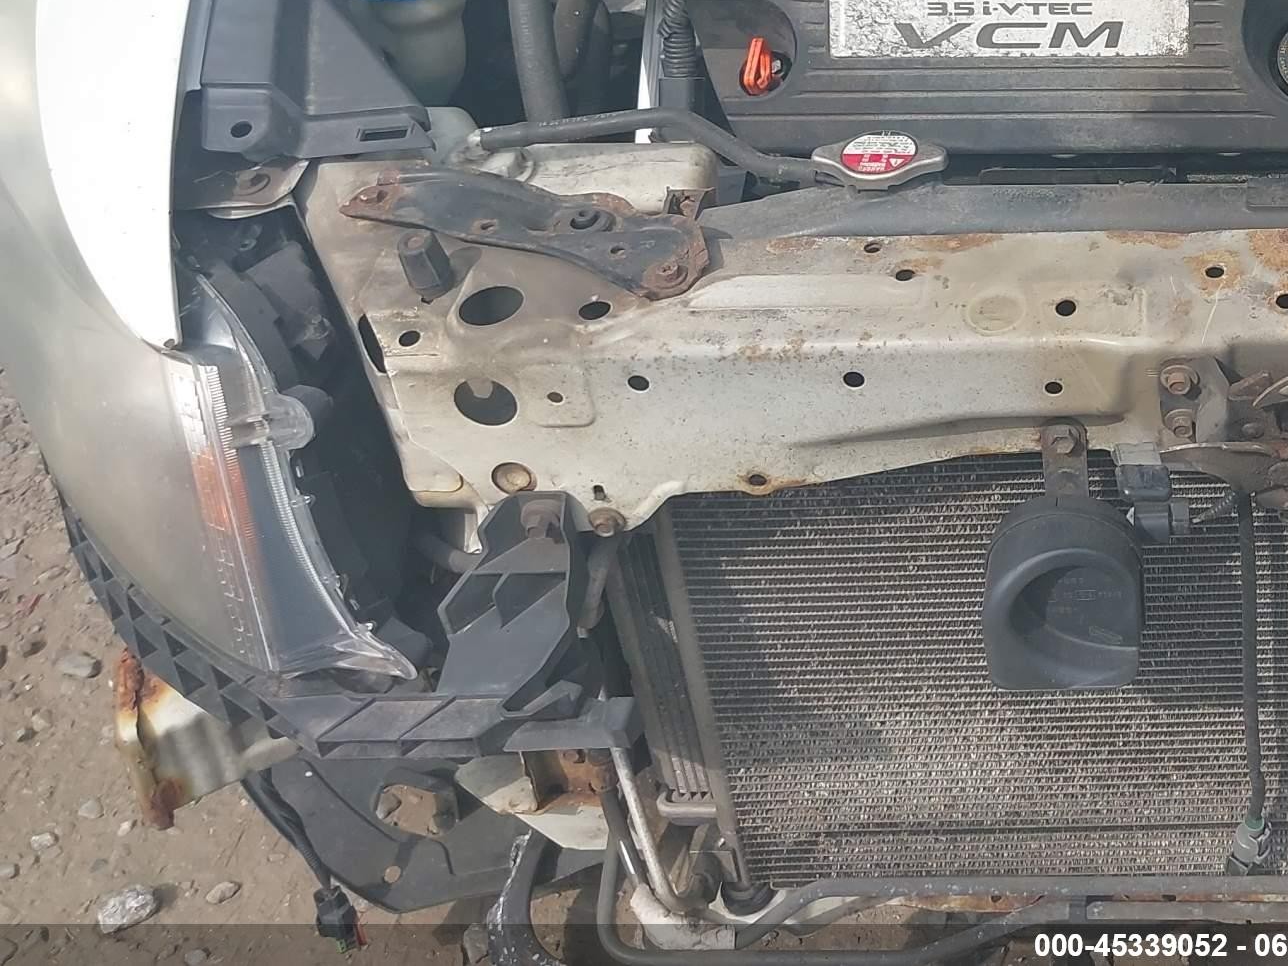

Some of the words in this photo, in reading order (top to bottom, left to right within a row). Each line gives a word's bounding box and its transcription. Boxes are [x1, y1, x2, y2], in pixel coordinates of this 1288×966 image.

[927, 2, 975, 16] 3.5
[982, 2, 1093, 16] i-VTEC
[893, 21, 1124, 49] VCM
